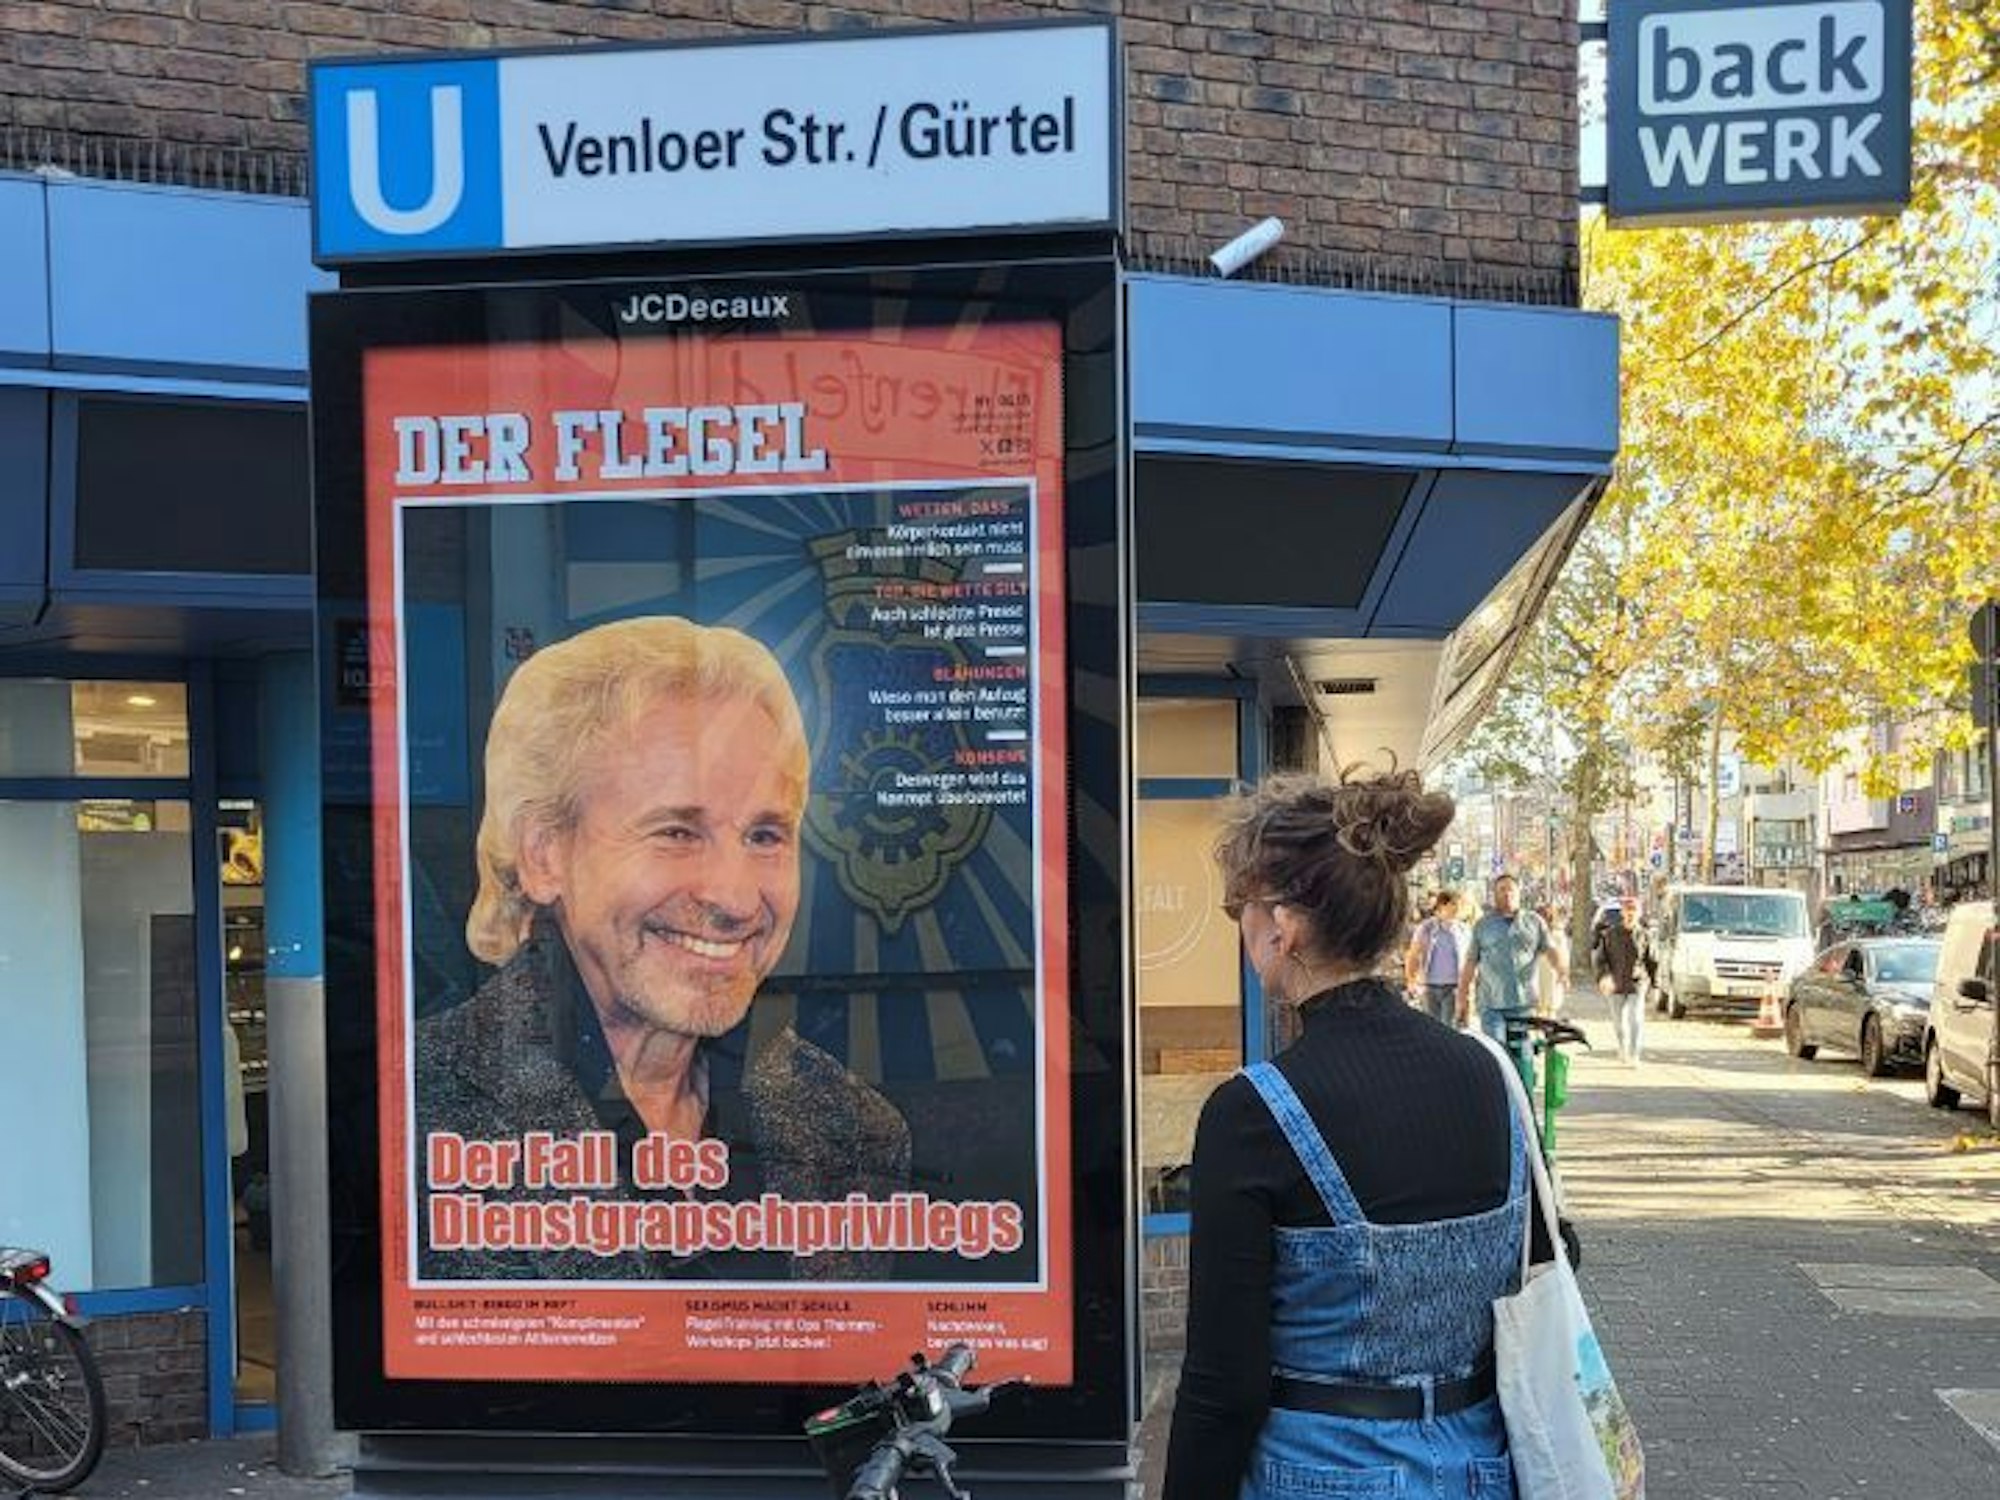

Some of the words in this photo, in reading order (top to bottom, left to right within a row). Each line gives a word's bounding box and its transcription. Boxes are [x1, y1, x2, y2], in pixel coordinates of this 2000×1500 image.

[1653, 15, 1867, 102] back
[346, 84, 465, 236] U
[538, 118, 745, 177] Venloer
[761, 108, 855, 164] Str.
[899, 97, 1076, 160] Gürtel
[1638, 112, 1882, 188] WERK
[620, 293, 788, 323] JCDecaux
[393, 412, 531, 486] DER
[552, 402, 829, 482] FLEGEL
[429, 1133, 519, 1189] Der
[523, 1132, 615, 1189] Fall
[634, 1132, 729, 1190] des
[429, 1191, 1025, 1258] Dienstgrapschprivilegs
